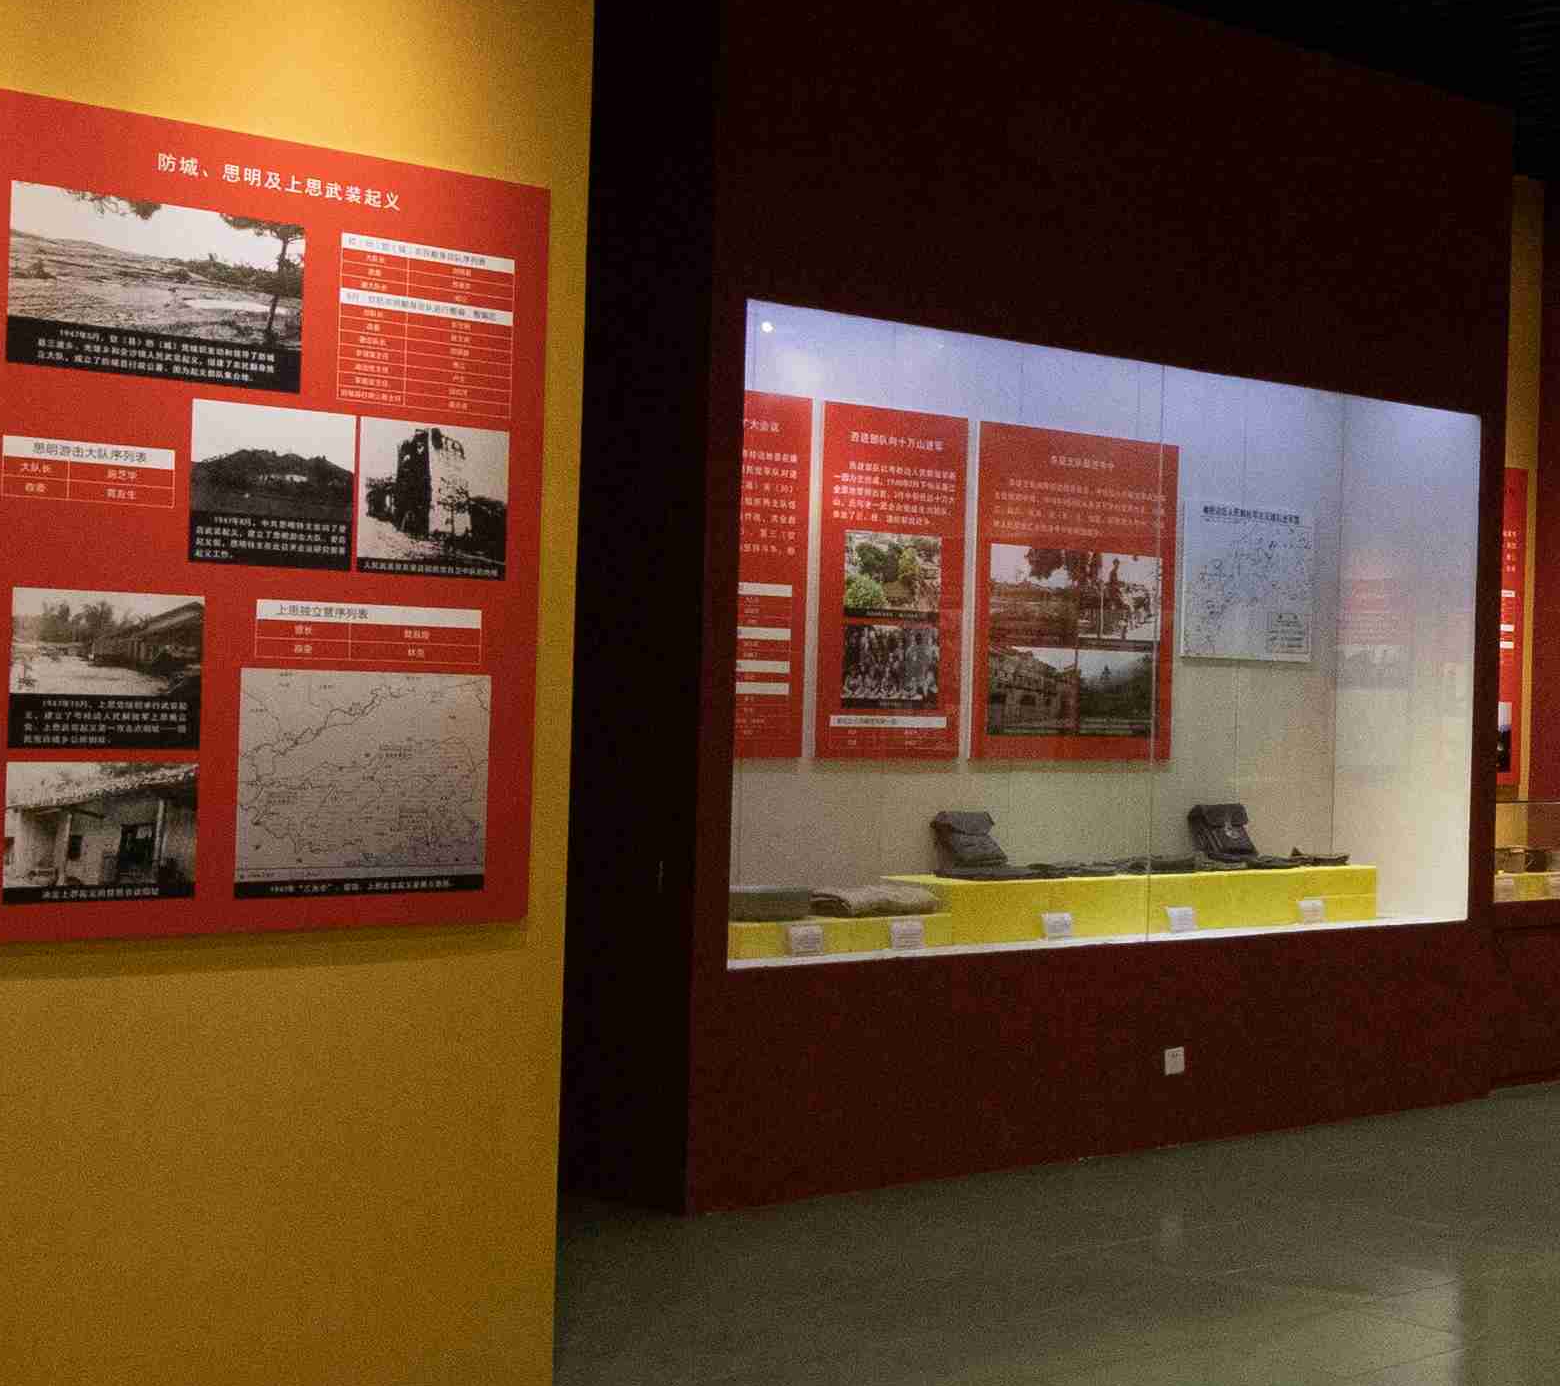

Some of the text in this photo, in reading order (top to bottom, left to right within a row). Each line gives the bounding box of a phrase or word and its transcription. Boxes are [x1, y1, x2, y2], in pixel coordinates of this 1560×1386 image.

[157, 152, 401, 210] 防城、思明及上思武装起义
